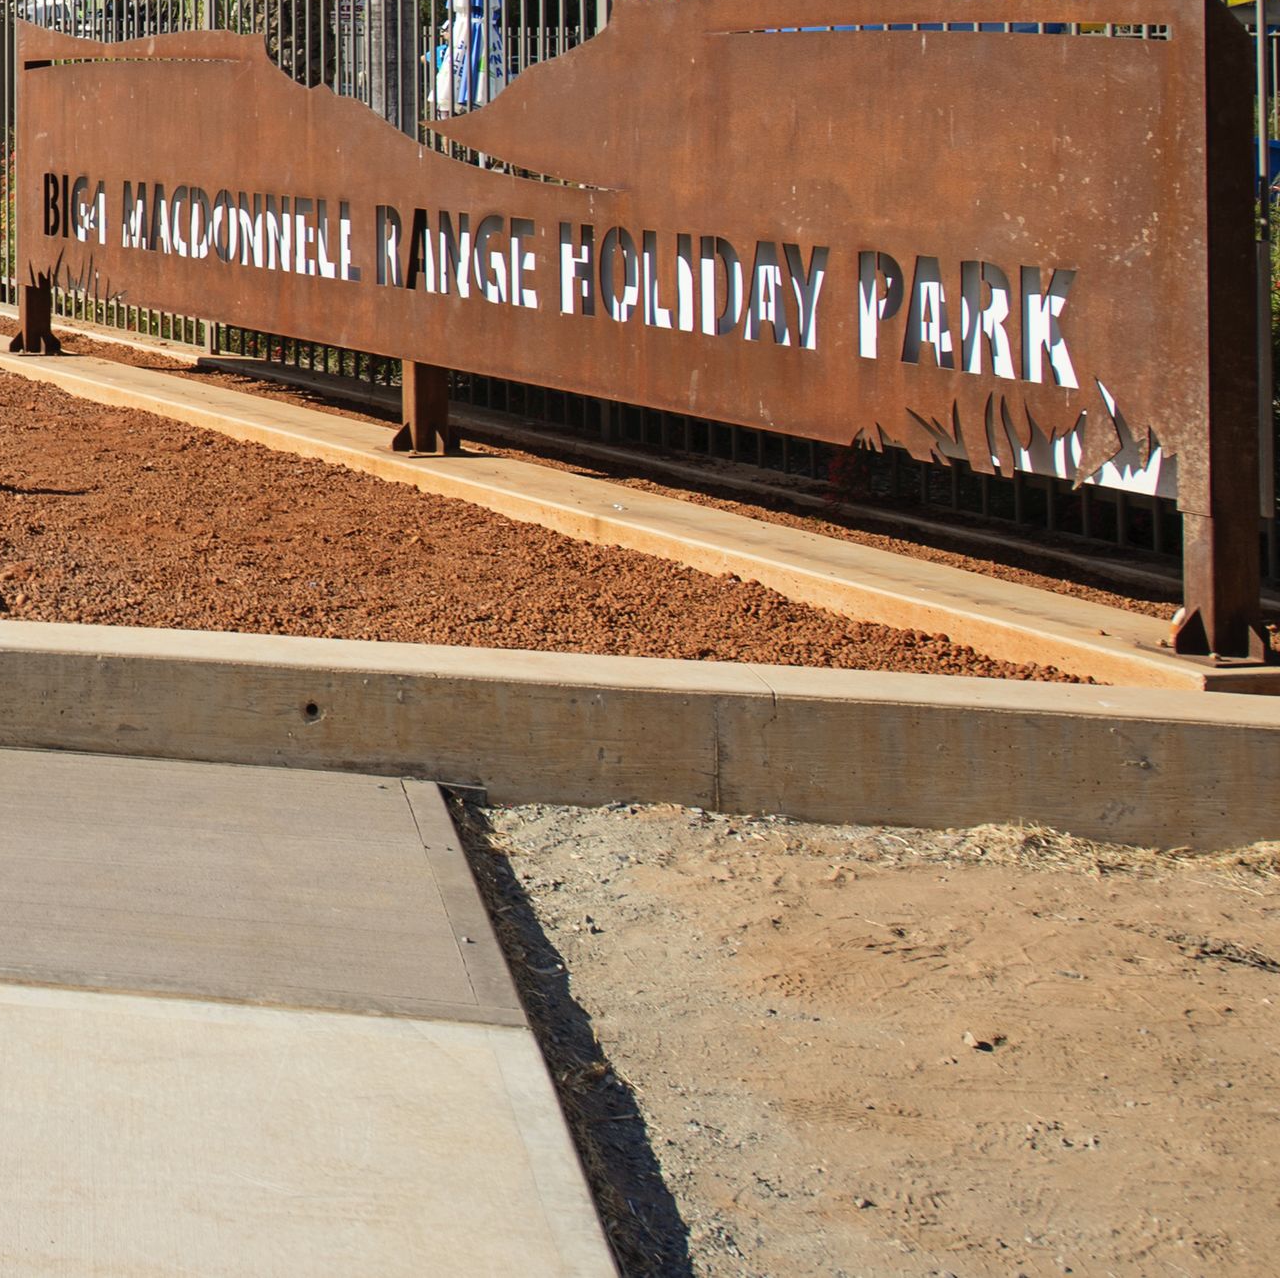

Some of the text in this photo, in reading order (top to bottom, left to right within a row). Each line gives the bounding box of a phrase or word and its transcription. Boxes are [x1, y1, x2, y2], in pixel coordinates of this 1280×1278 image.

[43, 172, 1080, 390] BIG4 MACDONNELL RANGE HOLIDAY PARK
